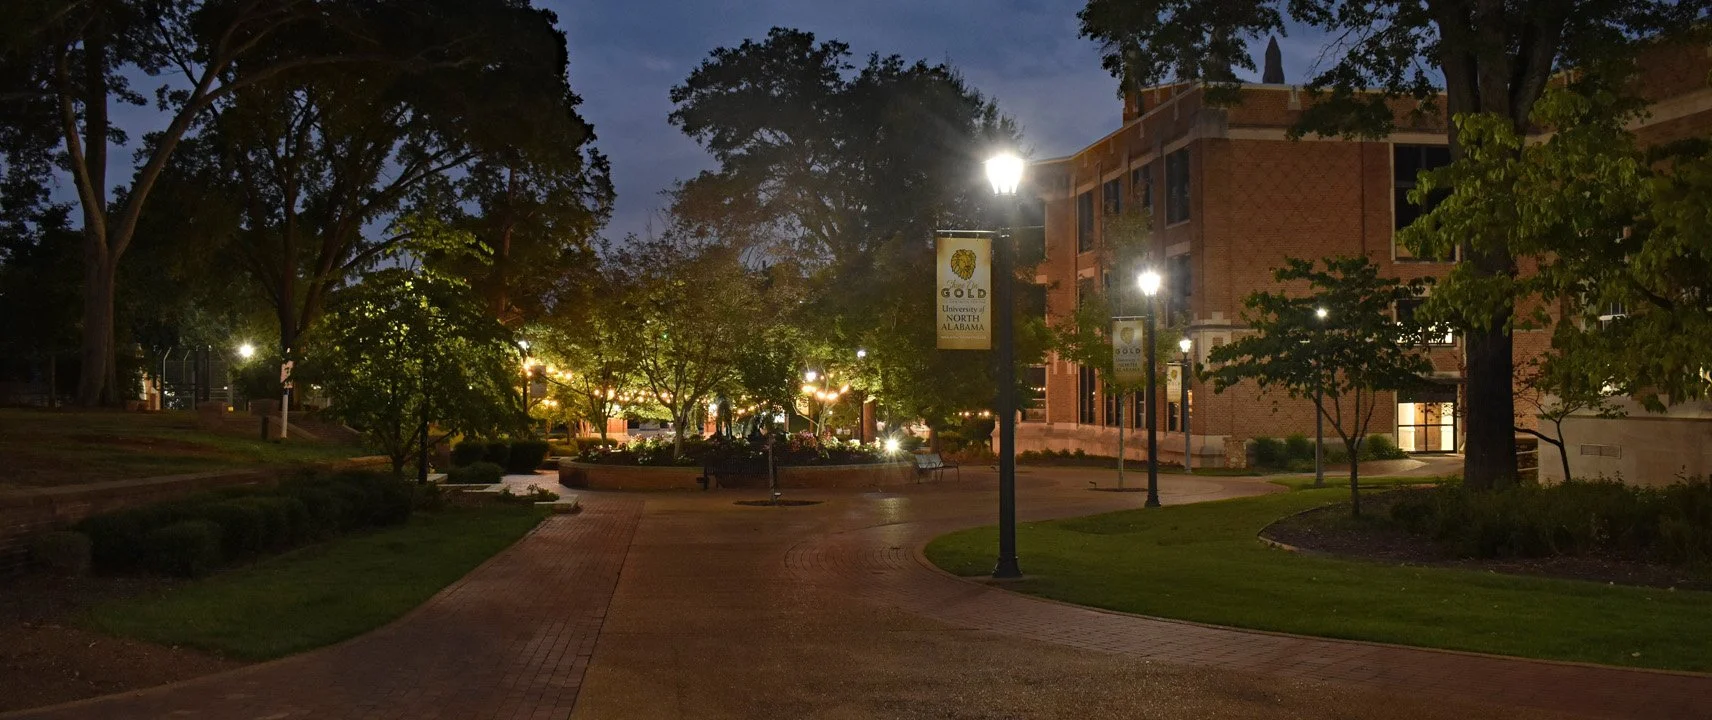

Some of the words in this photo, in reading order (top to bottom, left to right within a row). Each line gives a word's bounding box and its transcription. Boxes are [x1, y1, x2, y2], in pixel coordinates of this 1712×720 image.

[941, 288, 987, 298] GOLD
[942, 305, 977, 313] University
[946, 314, 980, 322] NORTH
[941, 323, 984, 331] ALABAMA
